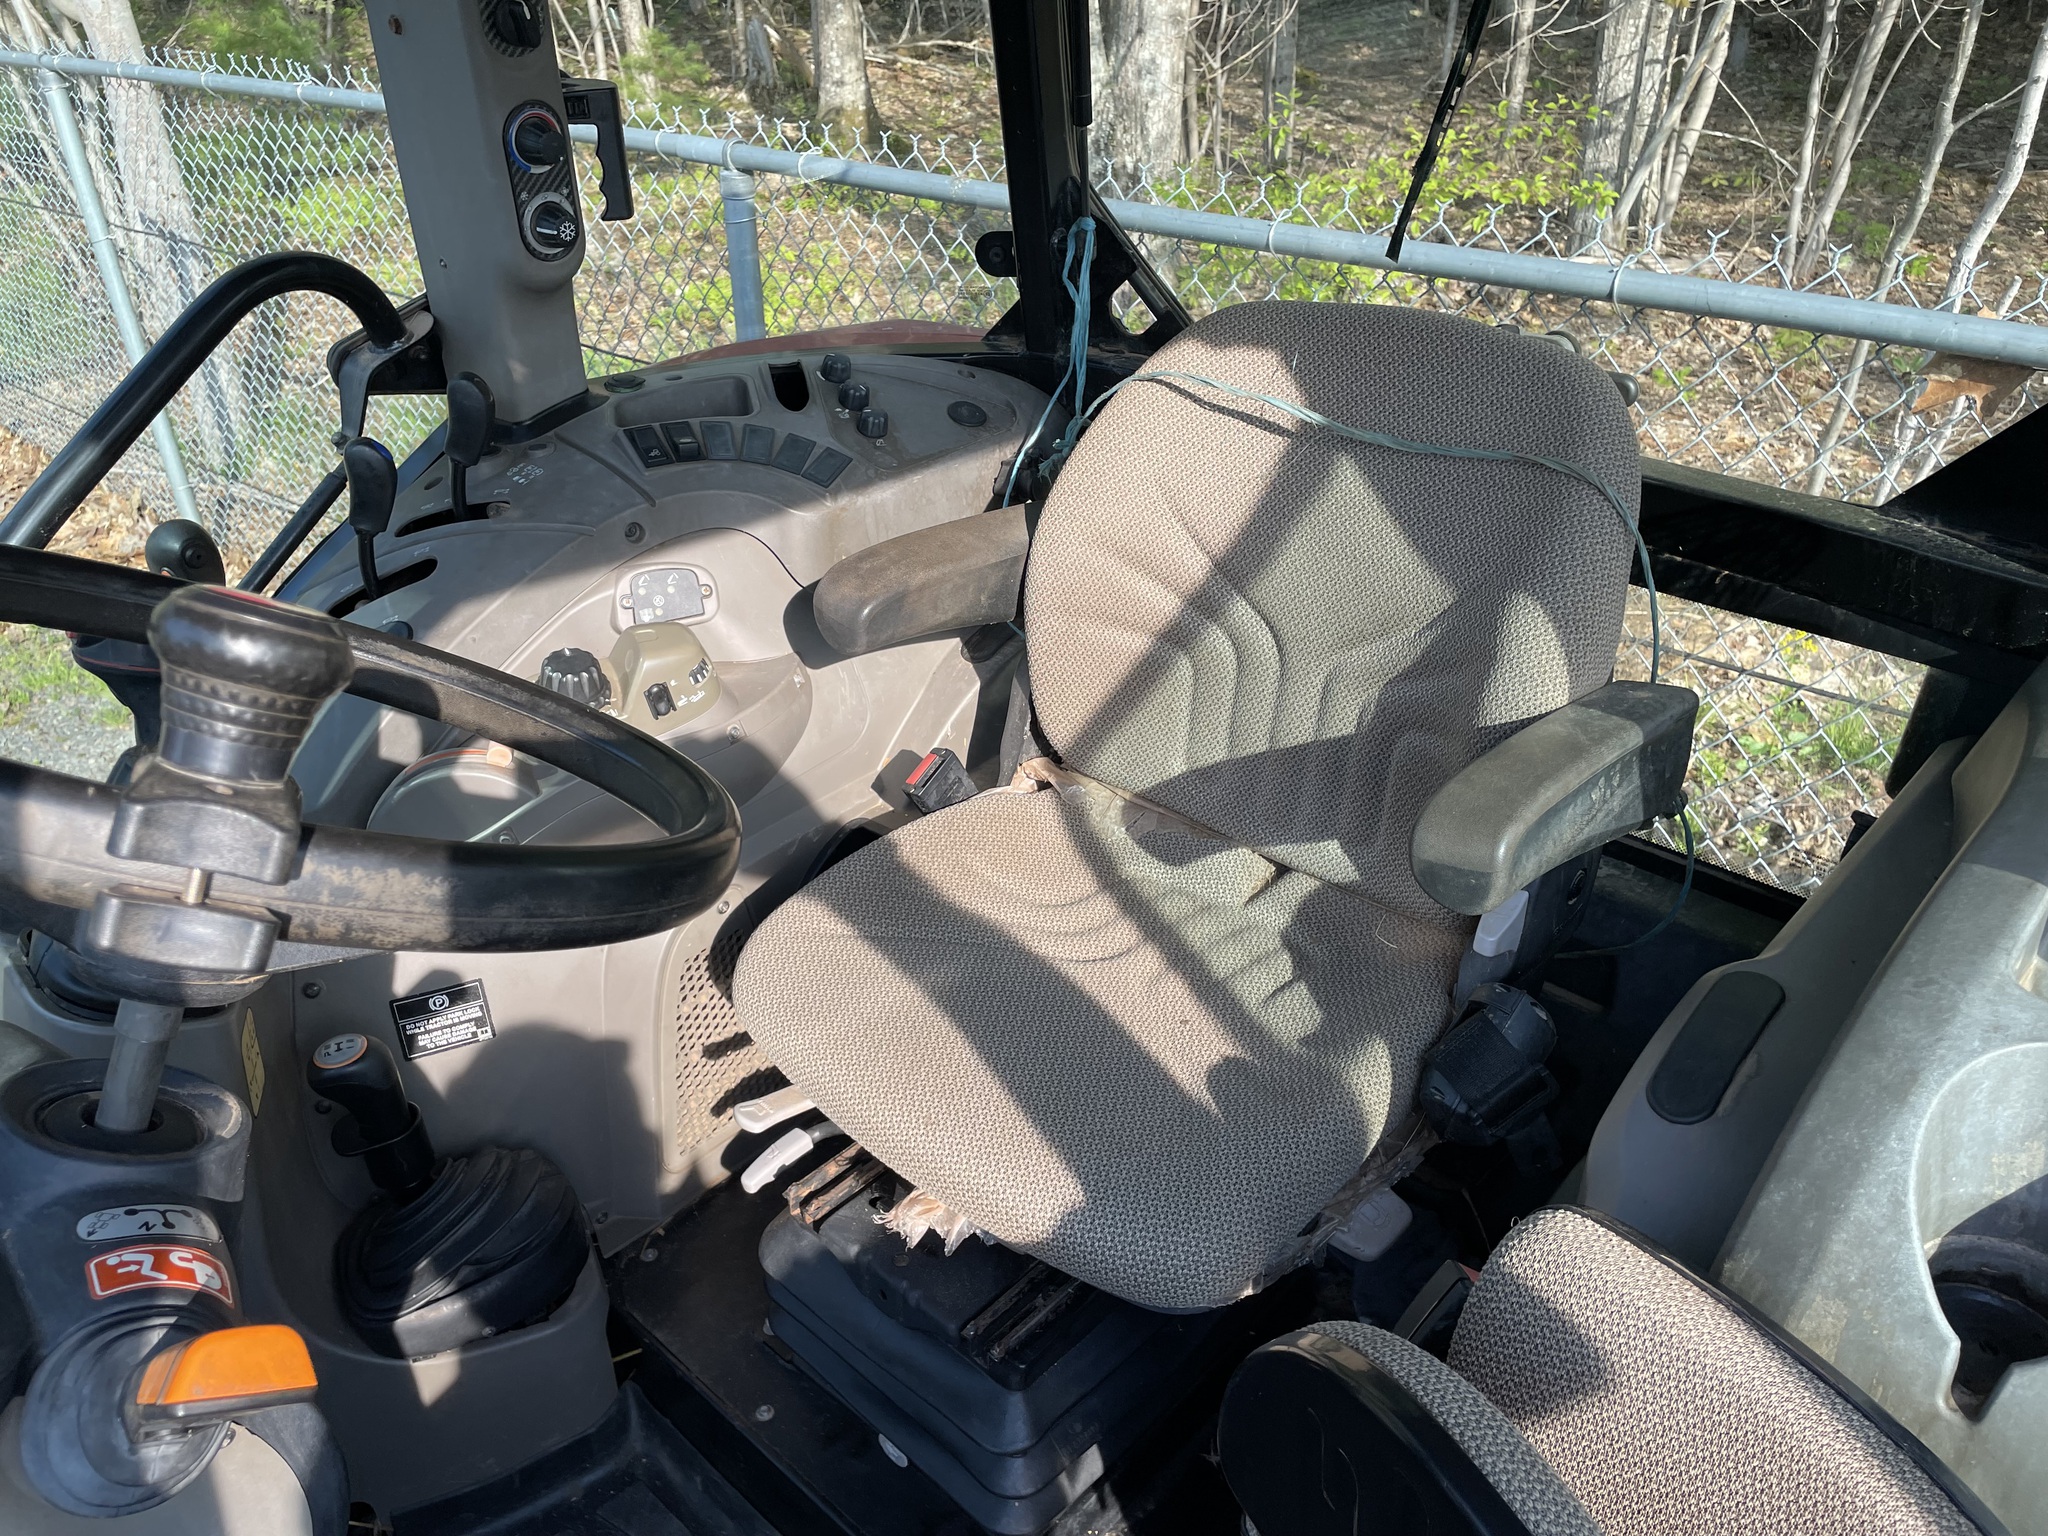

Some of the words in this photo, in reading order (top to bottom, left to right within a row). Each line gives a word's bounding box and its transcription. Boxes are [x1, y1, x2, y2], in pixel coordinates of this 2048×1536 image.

[435, 998, 443, 1007] P
[406, 1027, 425, 1035] WHILE
[426, 1020, 453, 1030] TRACTOR
[460, 1011, 483, 1022] MOVING
[429, 1015, 447, 1024] APPLY
[447, 1011, 463, 1019] PARK
[464, 1006, 480, 1014] LOCK
[417, 1030, 443, 1040] FAILURE
[451, 1021, 475, 1031] COMPLY
[432, 1033, 452, 1043] CAUSE
[452, 1026, 477, 1037] DAMAGE
[435, 1039, 448, 1047] THE
[448, 1033, 472, 1043] VEHICLE
